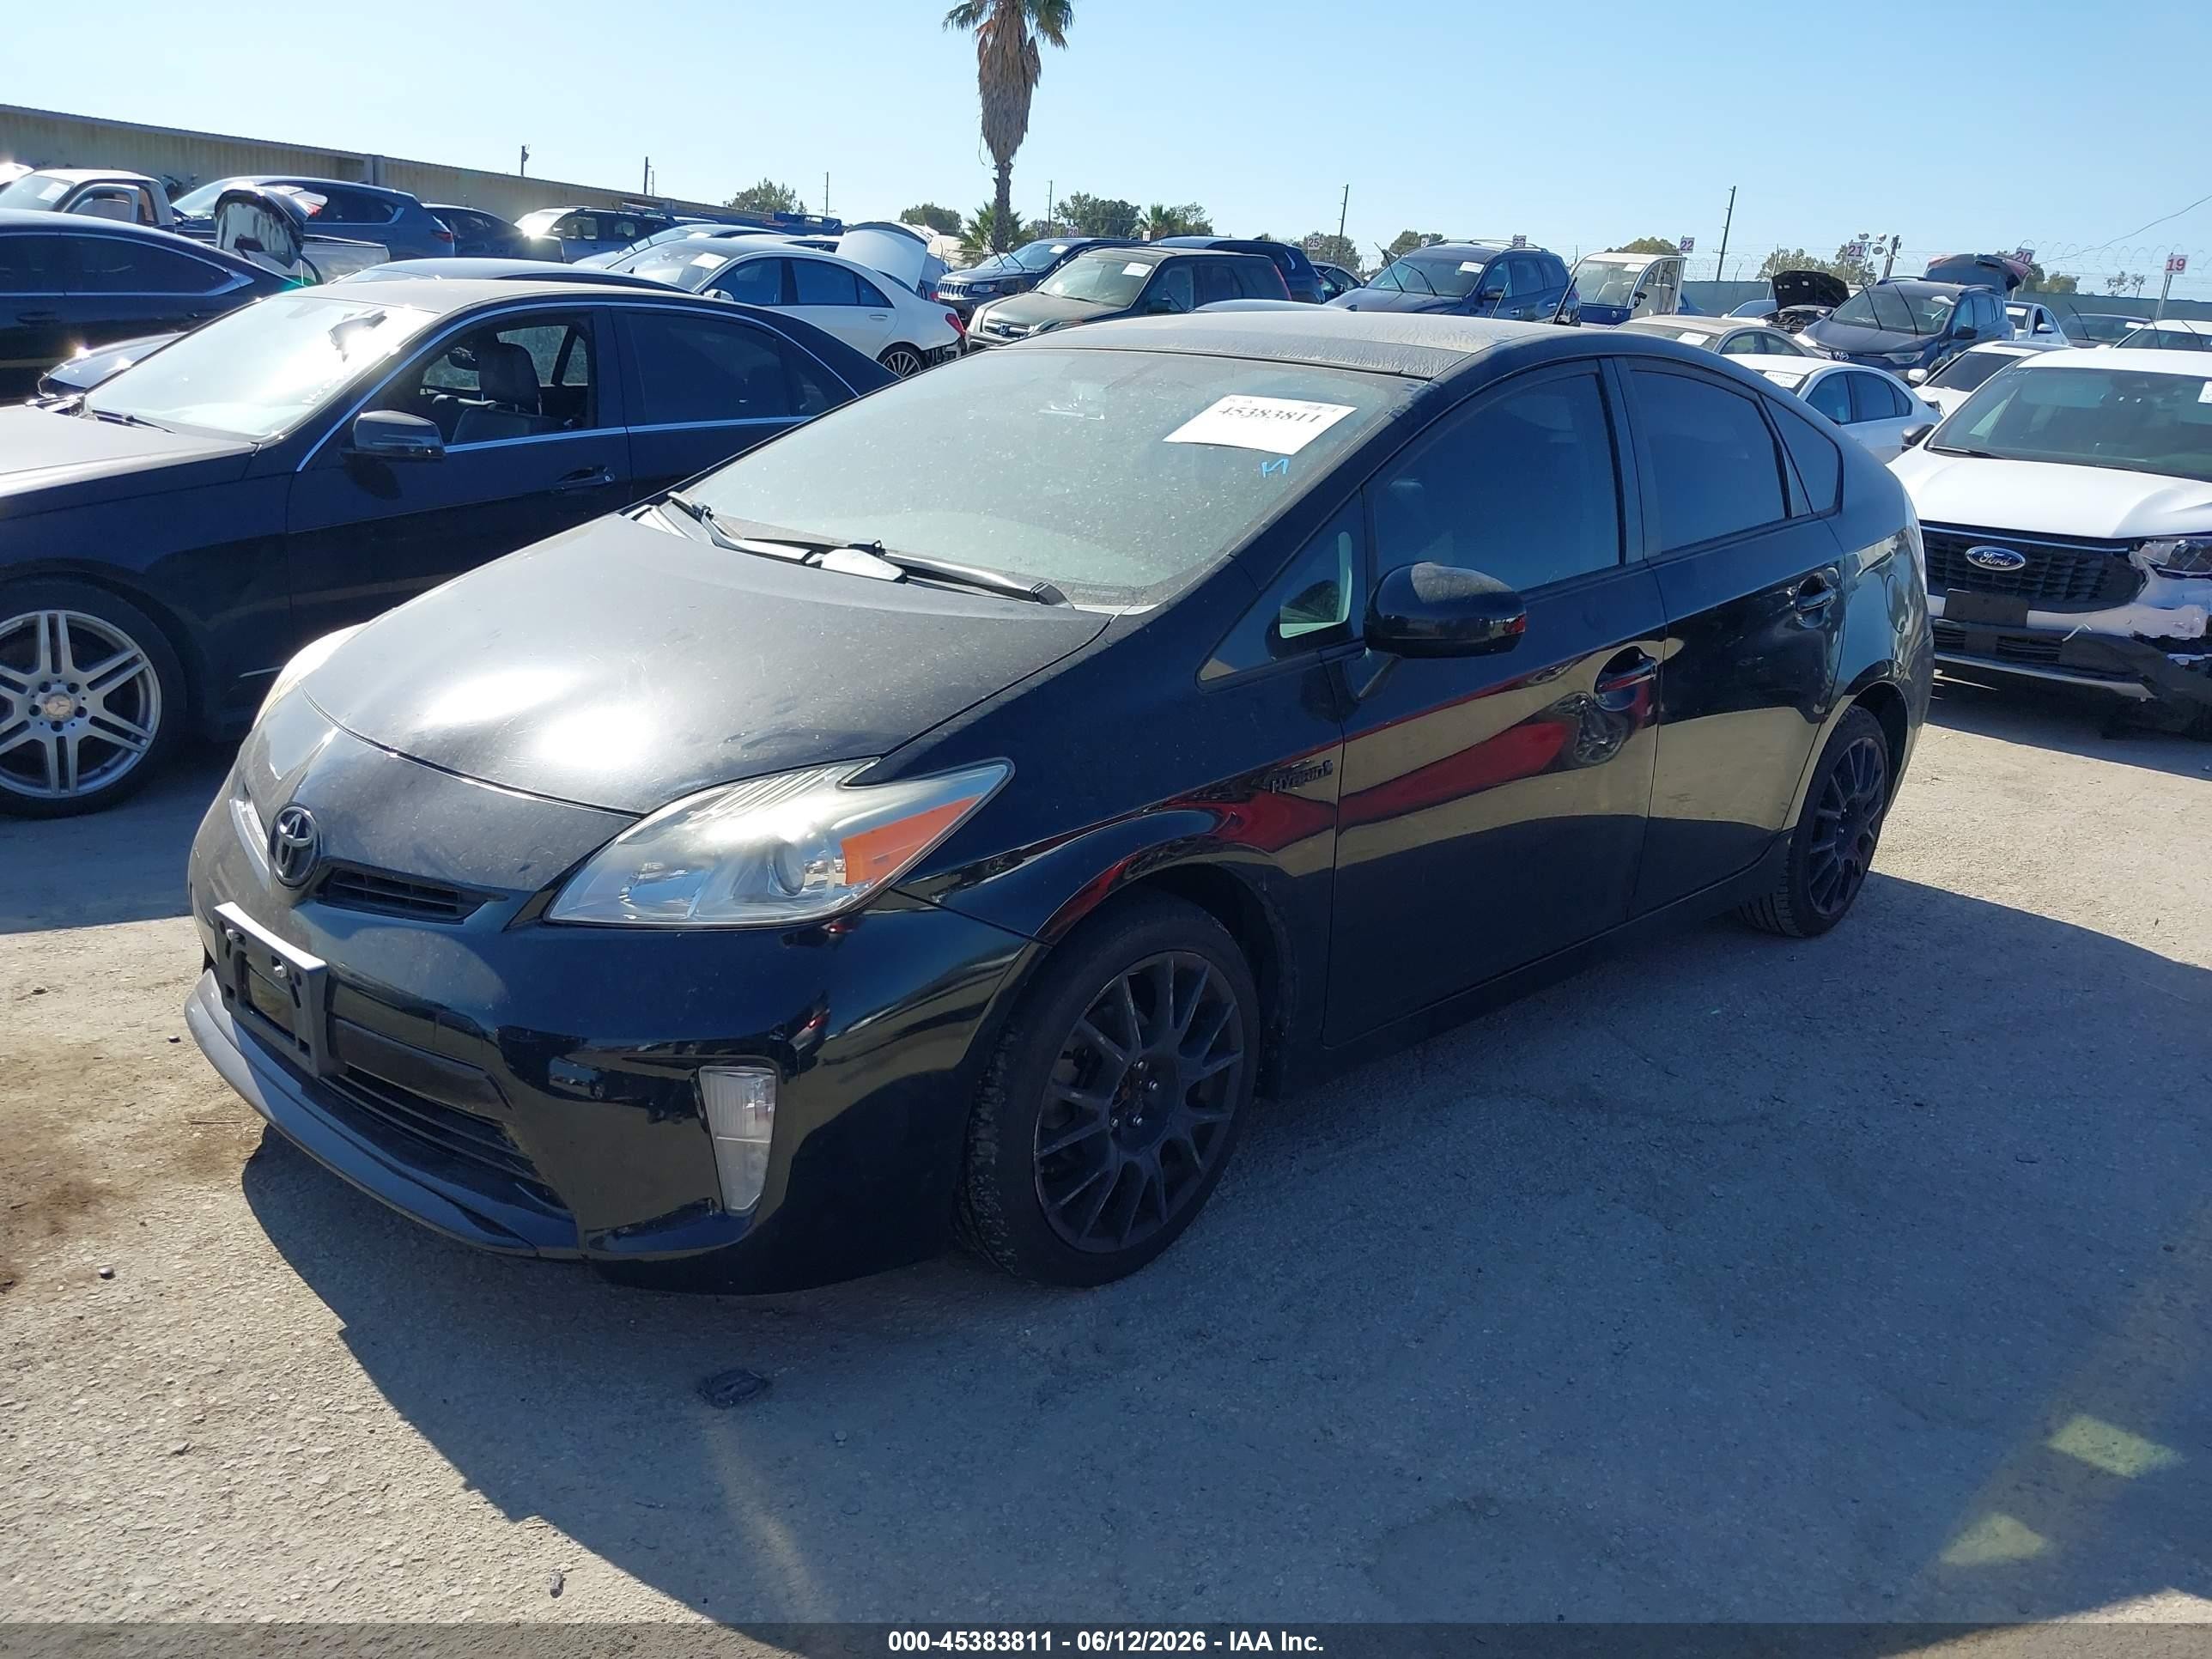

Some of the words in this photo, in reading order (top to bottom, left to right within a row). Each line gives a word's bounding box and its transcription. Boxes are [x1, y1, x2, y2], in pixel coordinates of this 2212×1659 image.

[1308, 237, 1319, 247] 25
[1680, 240, 1694, 251] 22
[1848, 245, 1863, 256] 21
[2014, 251, 2033, 264] 20
[2166, 258, 2186, 271] 19
[1218, 406, 1322, 423] 45383811
[1978, 551, 2012, 566] Ford
